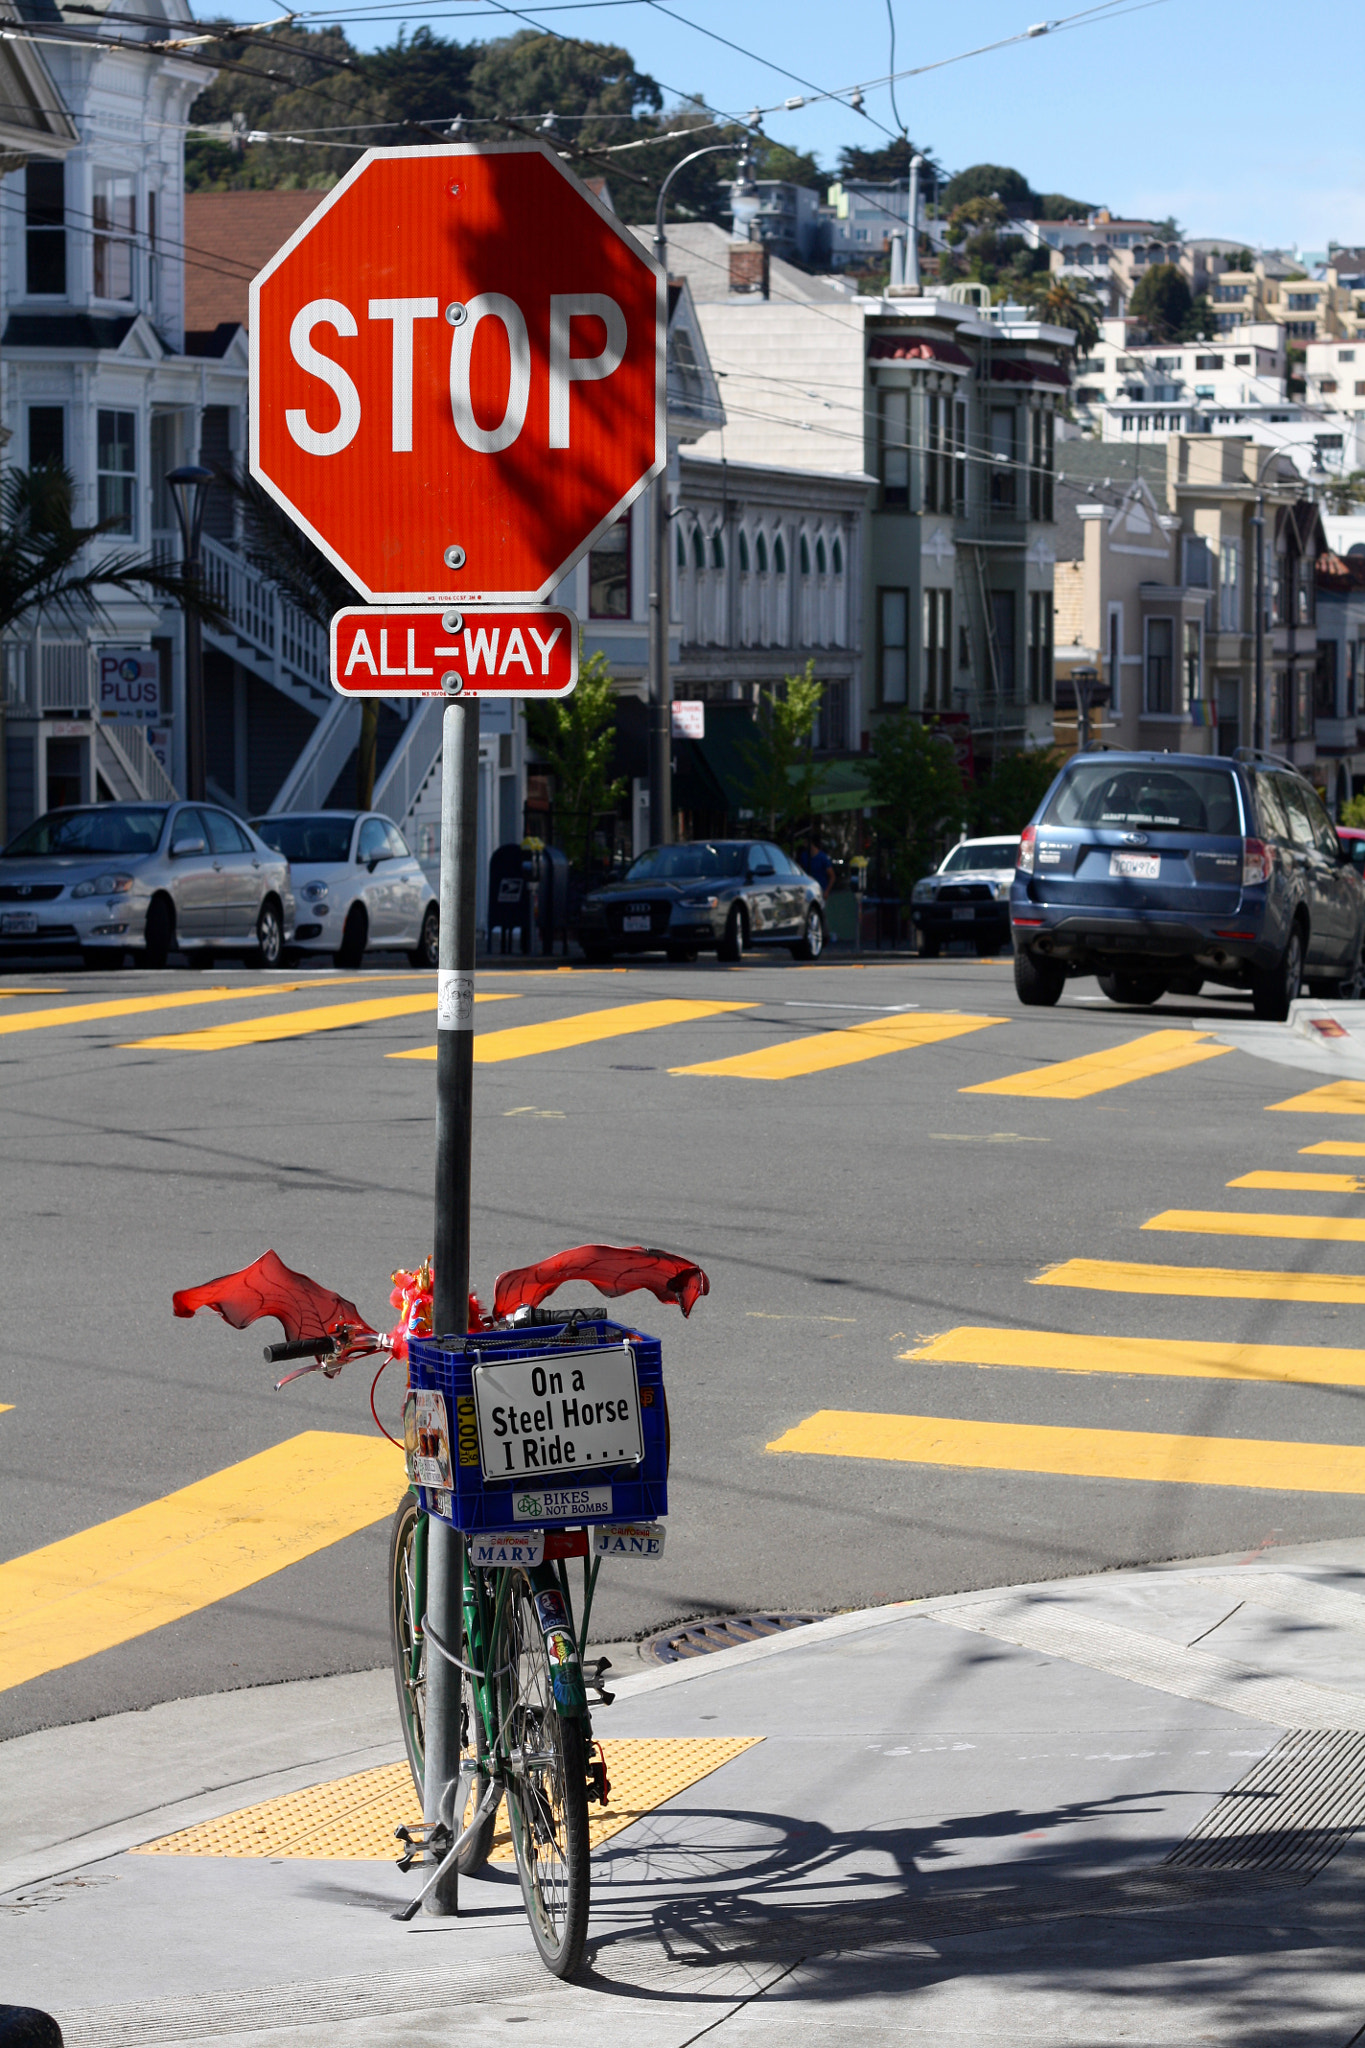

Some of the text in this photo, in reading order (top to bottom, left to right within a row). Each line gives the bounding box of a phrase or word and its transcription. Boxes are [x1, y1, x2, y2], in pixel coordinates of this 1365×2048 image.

[285, 292, 628, 456] STOP
[101, 682, 157, 703] PLUS
[531, 1367, 585, 1397] On a
[491, 1398, 630, 1437] Steel Horse
[502, 1441, 515, 1471] I
[522, 1434, 576, 1468] Ride
[543, 1491, 589, 1506] BIKES
[545, 1502, 608, 1515] NOT BOMBS
[477, 1546, 538, 1561] MARY
[599, 1535, 660, 1554] JANE
